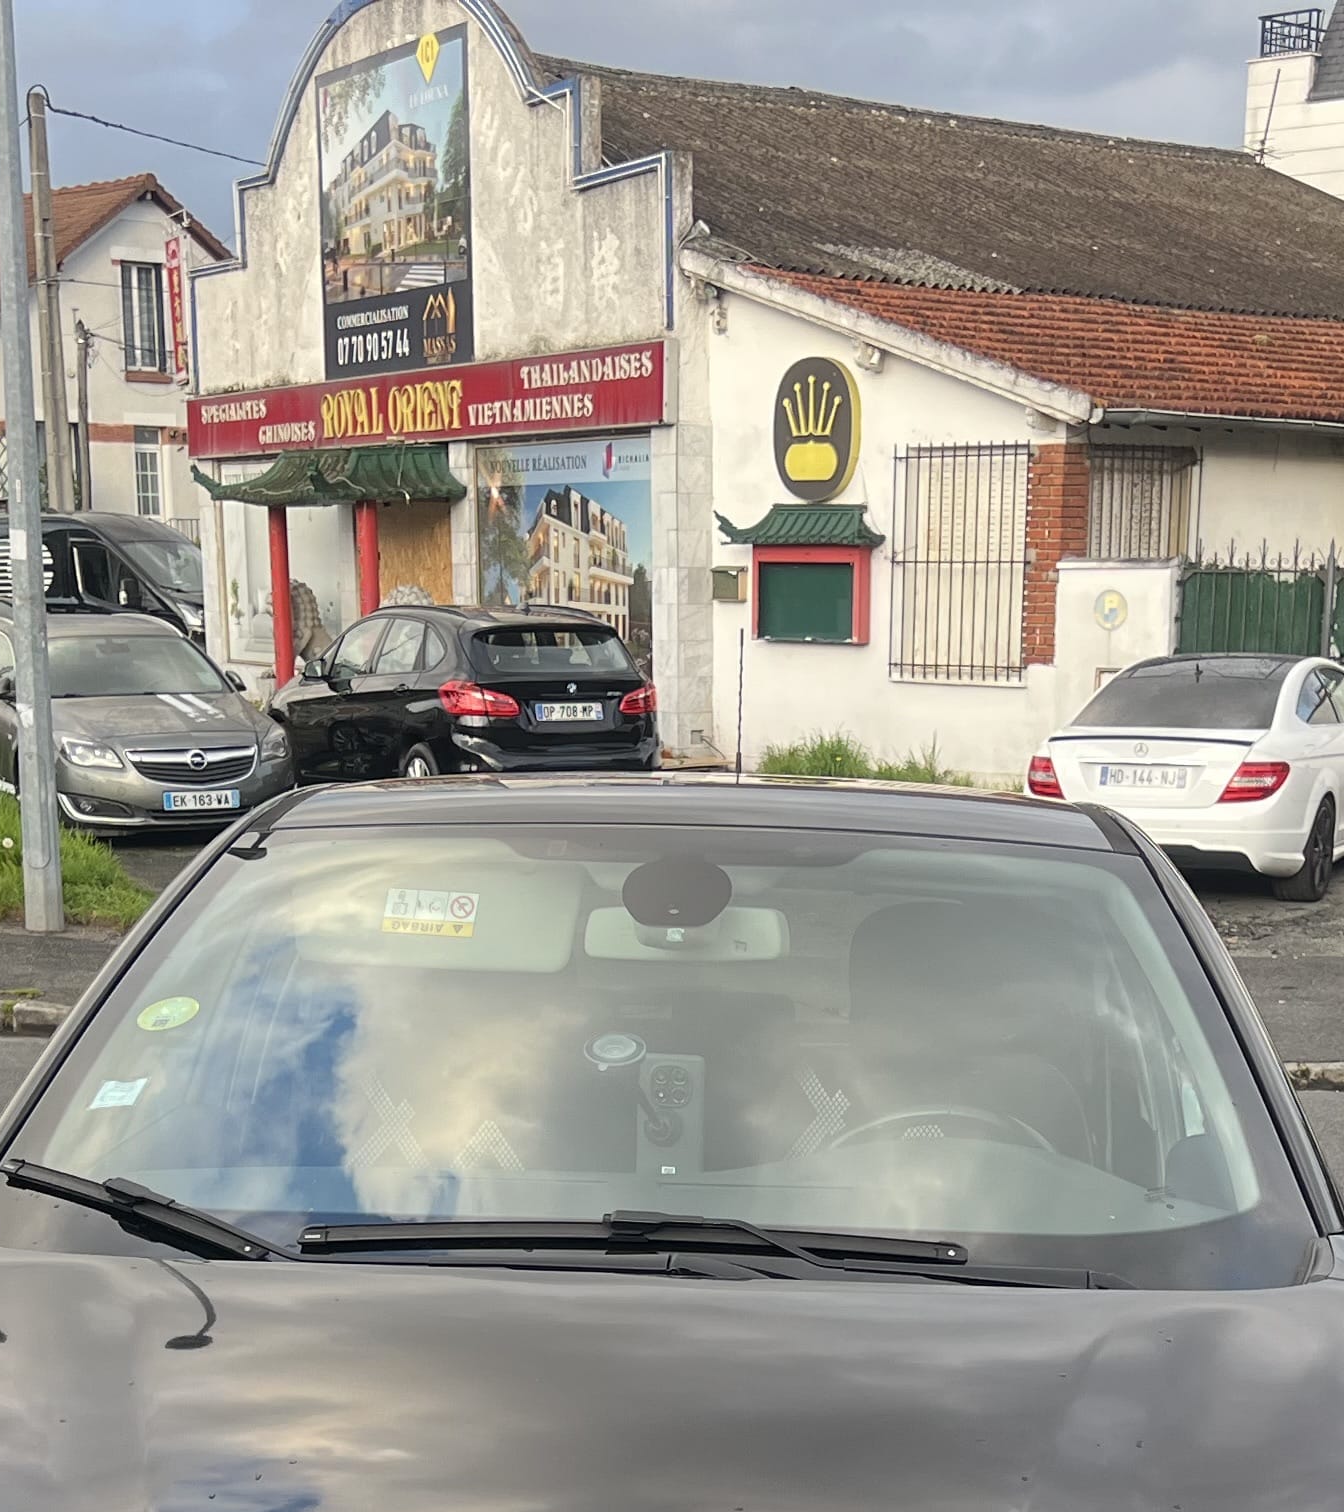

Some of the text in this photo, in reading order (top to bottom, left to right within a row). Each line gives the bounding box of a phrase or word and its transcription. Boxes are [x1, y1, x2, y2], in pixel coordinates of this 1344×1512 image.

[337, 305, 409, 329] COMMERCIALISATION
[338, 337, 349, 366] 07
[351, 335, 364, 363] 70
[366, 332, 378, 362] 90
[381, 330, 393, 359] 57
[396, 328, 410, 357] 44
[520, 351, 653, 389] THAILANDAISES
[201, 399, 267, 424] SPECIALITES
[321, 379, 463, 439] ROYAL ORIENT
[468, 393, 593, 426] VIETNAMIENNES
[259, 421, 316, 445] CHINOISES
[531, 452, 587, 472] RÉALISATION
[391, 920, 444, 933] AIRBAG
